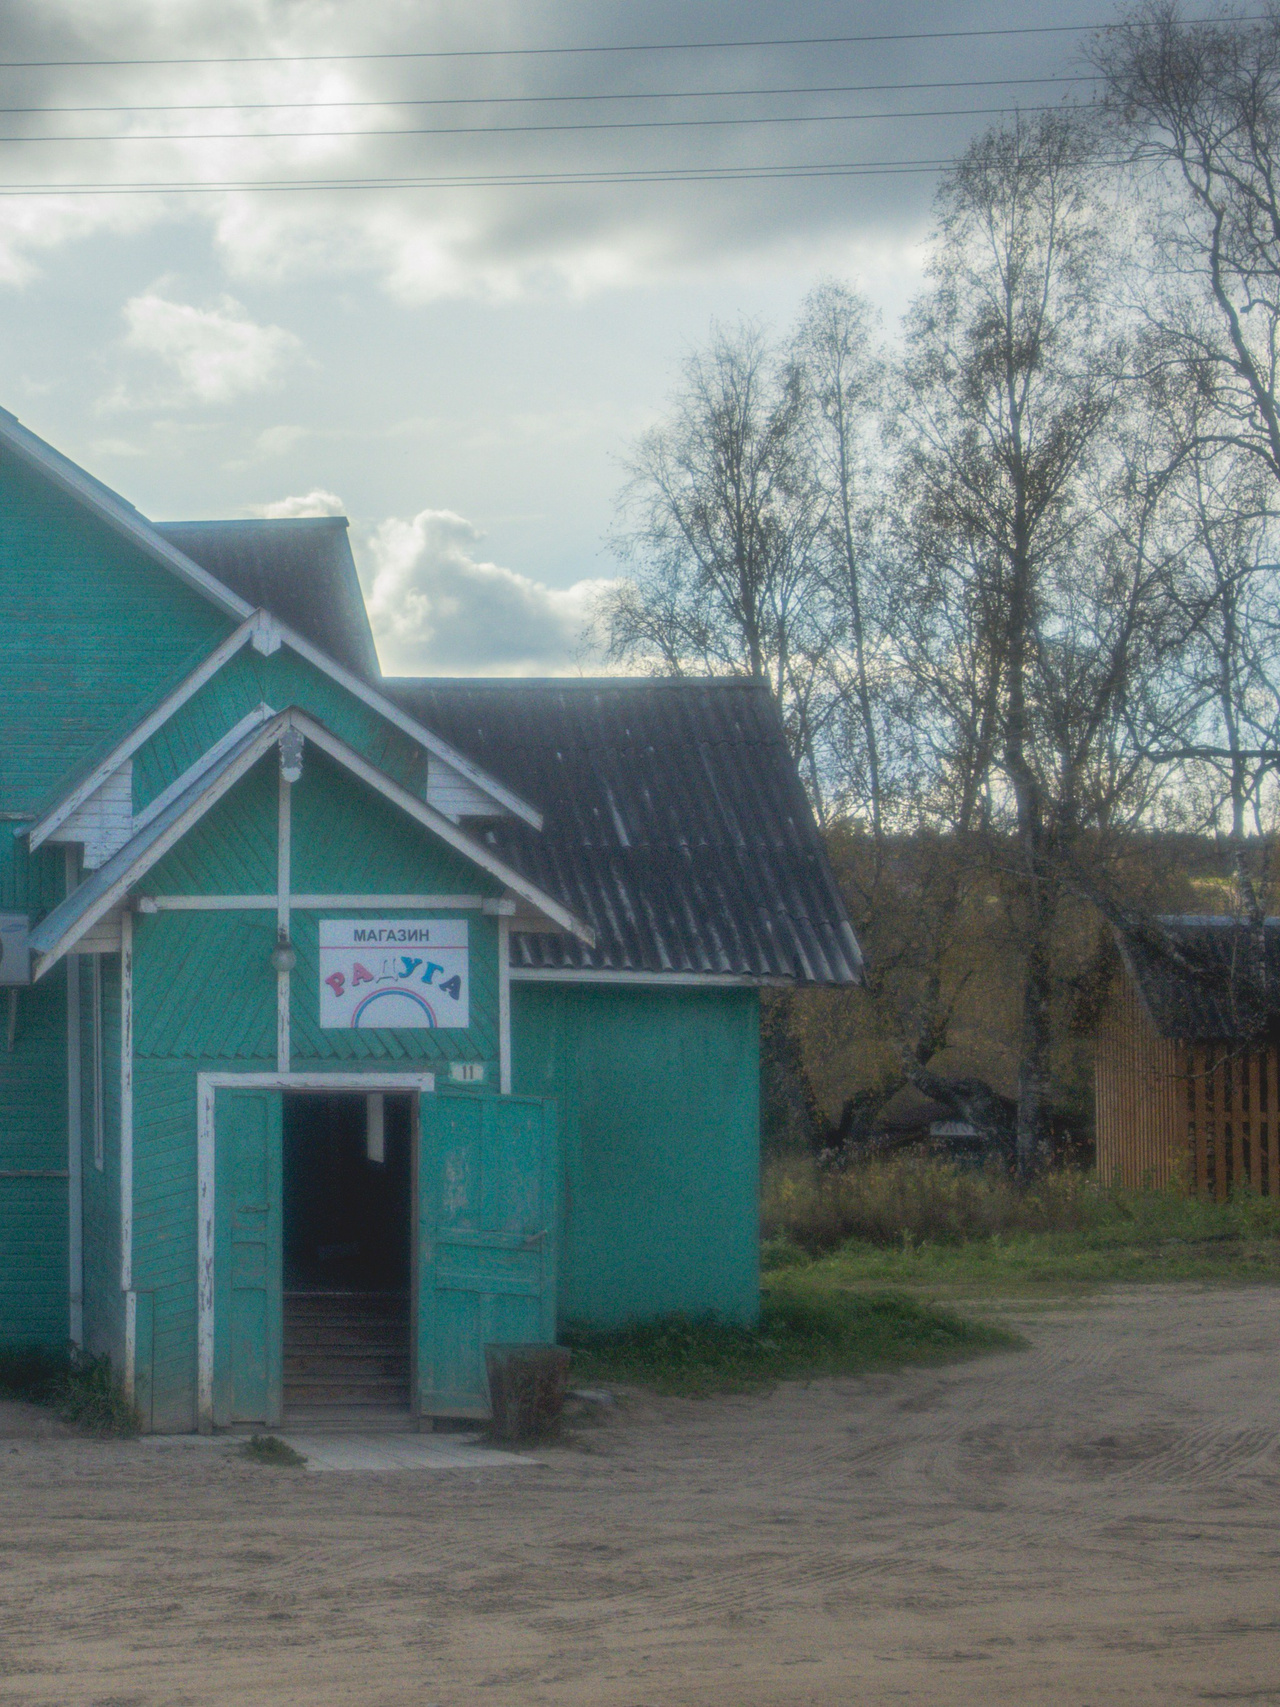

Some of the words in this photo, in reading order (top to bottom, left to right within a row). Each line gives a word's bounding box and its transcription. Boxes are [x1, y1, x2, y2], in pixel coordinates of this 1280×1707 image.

[353, 928, 430, 942] МАГАЗИН
[325, 956, 461, 1000] РАДУГА
[463, 1065, 473, 1080] 11
